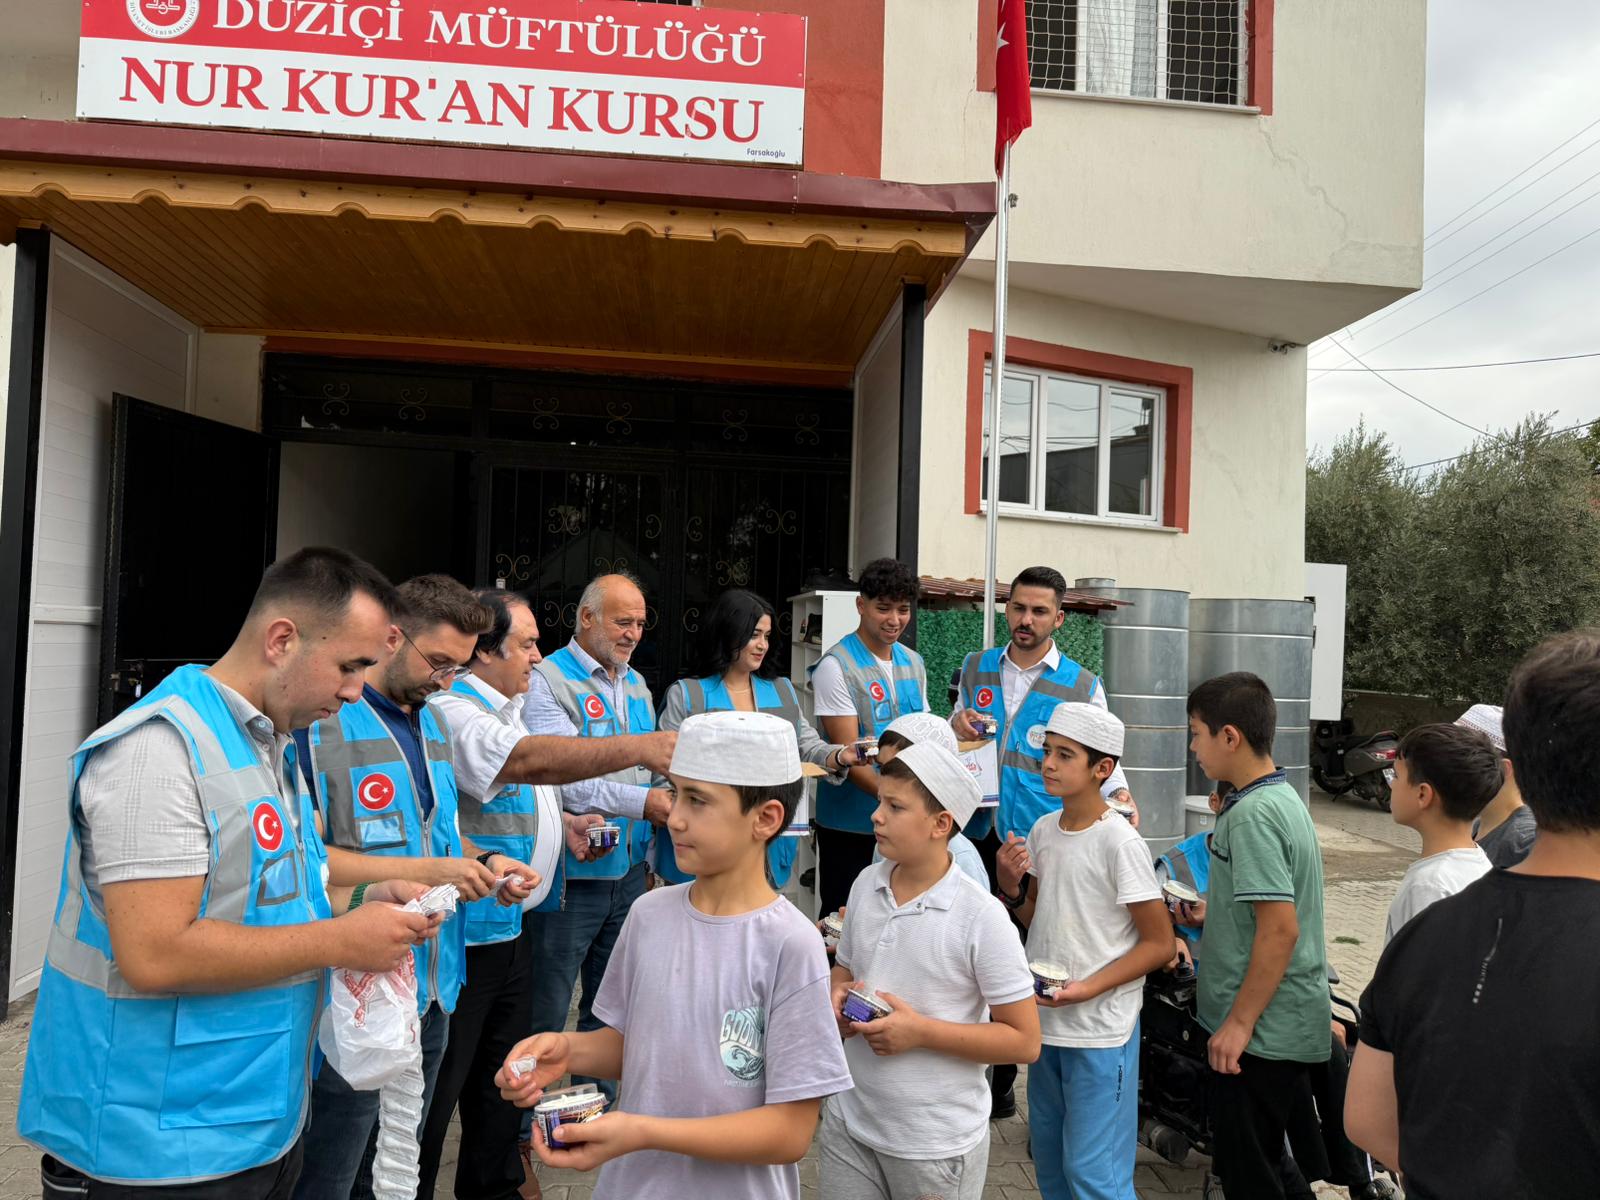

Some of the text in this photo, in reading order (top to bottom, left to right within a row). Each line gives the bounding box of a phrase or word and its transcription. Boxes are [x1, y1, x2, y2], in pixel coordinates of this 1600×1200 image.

[424, 6, 767, 67] MÜFTÜLÜĞÜ
[119, 56, 765, 143] NUR KUR'AN KURSU
